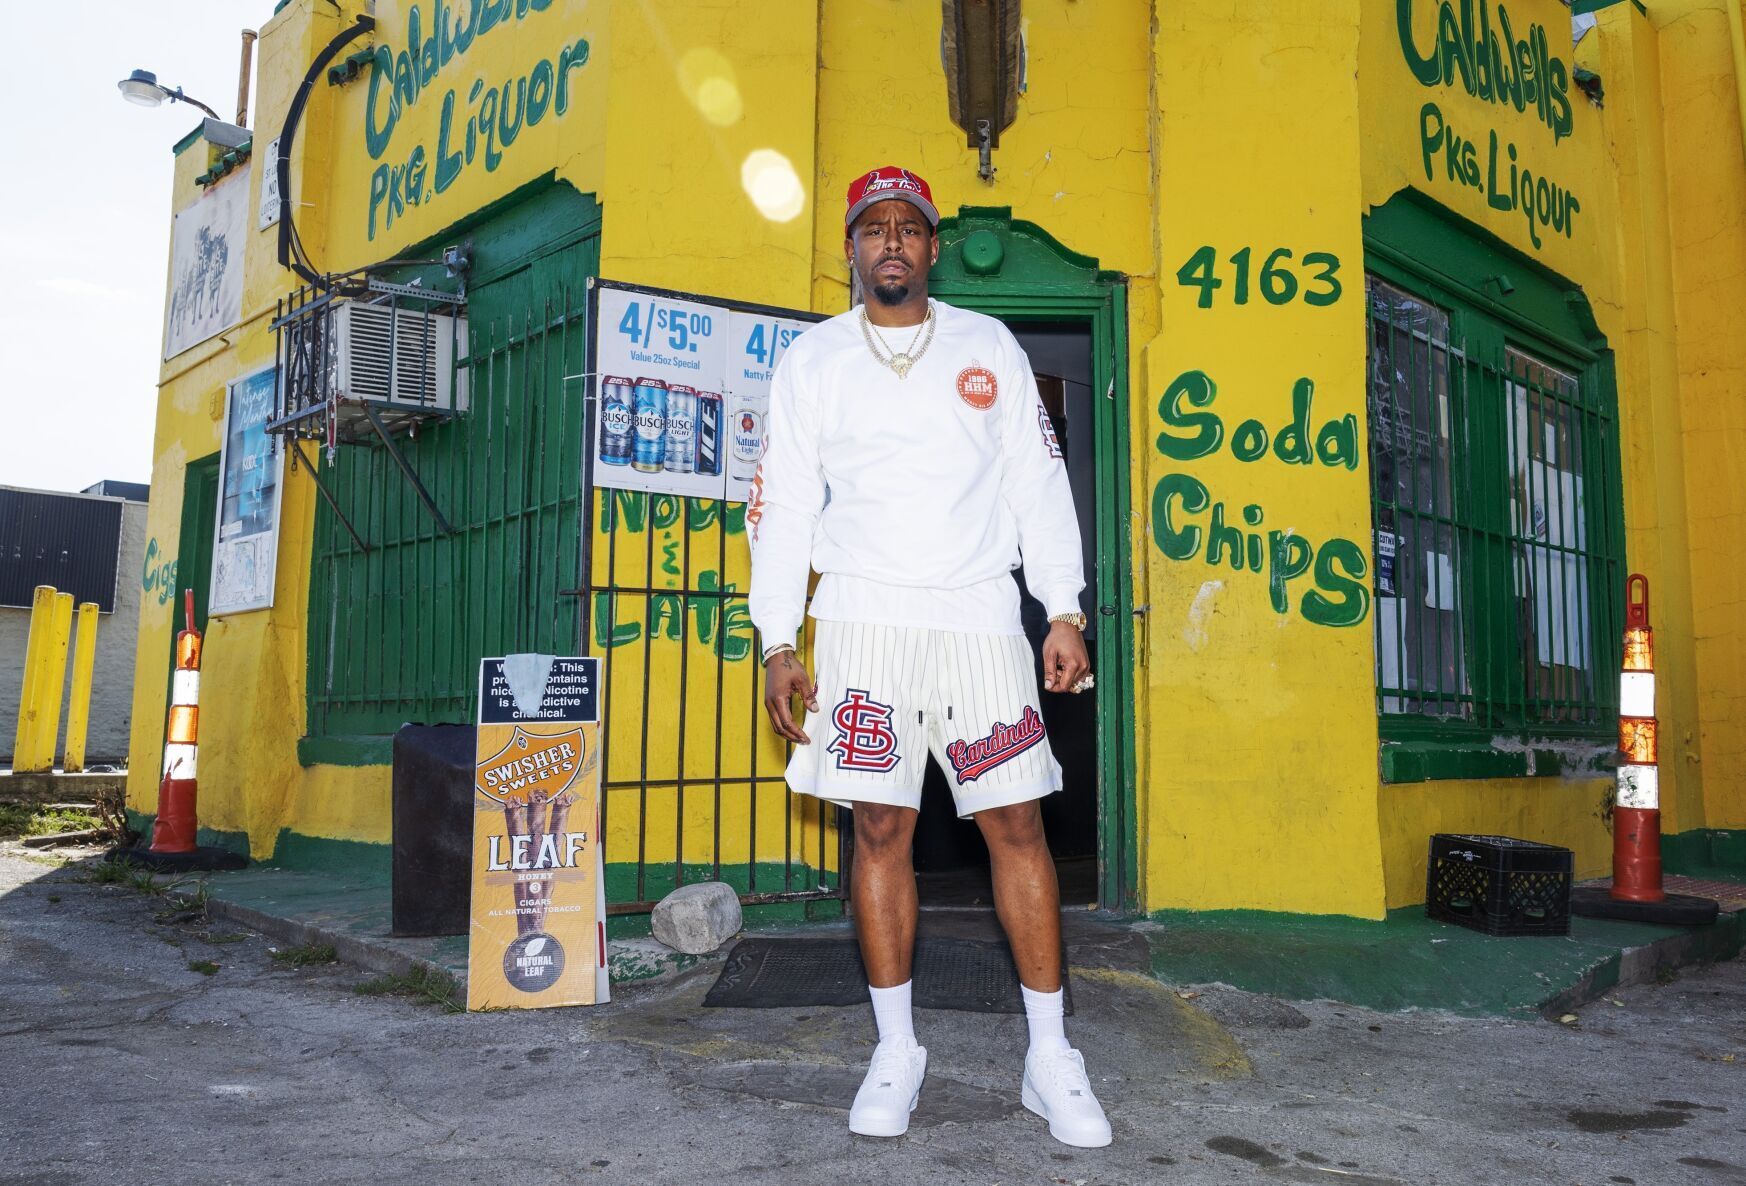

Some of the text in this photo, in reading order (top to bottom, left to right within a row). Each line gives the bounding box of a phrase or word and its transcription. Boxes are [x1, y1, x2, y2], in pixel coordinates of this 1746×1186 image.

[434, 39, 590, 194] Liquor
[1488, 129, 1580, 250] Liqour
[1176, 246, 1342, 308] 4163
[630, 350, 701, 370] Value 25oz Special
[744, 369, 765, 382] Natty
[964, 381, 993, 394] HHM
[602, 410, 632, 425] BUSCH
[634, 415, 666, 429] BUSCH
[1156, 370, 1359, 471] Soda
[666, 418, 695, 431] BUSCH
[701, 401, 716, 464] ICE
[735, 435, 760, 447] Natural
[594, 570, 766, 667] LATE
[560, 662, 584, 672] This
[547, 674, 588, 684] ontains
[544, 685, 589, 695] Nicotine
[499, 698, 509, 707] is
[540, 697, 581, 706] dictive
[946, 705, 1045, 774] Cardinals
[483, 742, 576, 787] SWISHER
[498, 760, 574, 795] SWEETS
[486, 832, 587, 872] LEAF
[517, 873, 553, 881] HONEY
[519, 899, 552, 907] CIGARS
[543, 905, 581, 914] TOBACCO
[516, 955, 554, 966] NATURAL
[524, 966, 545, 977] LEAF
